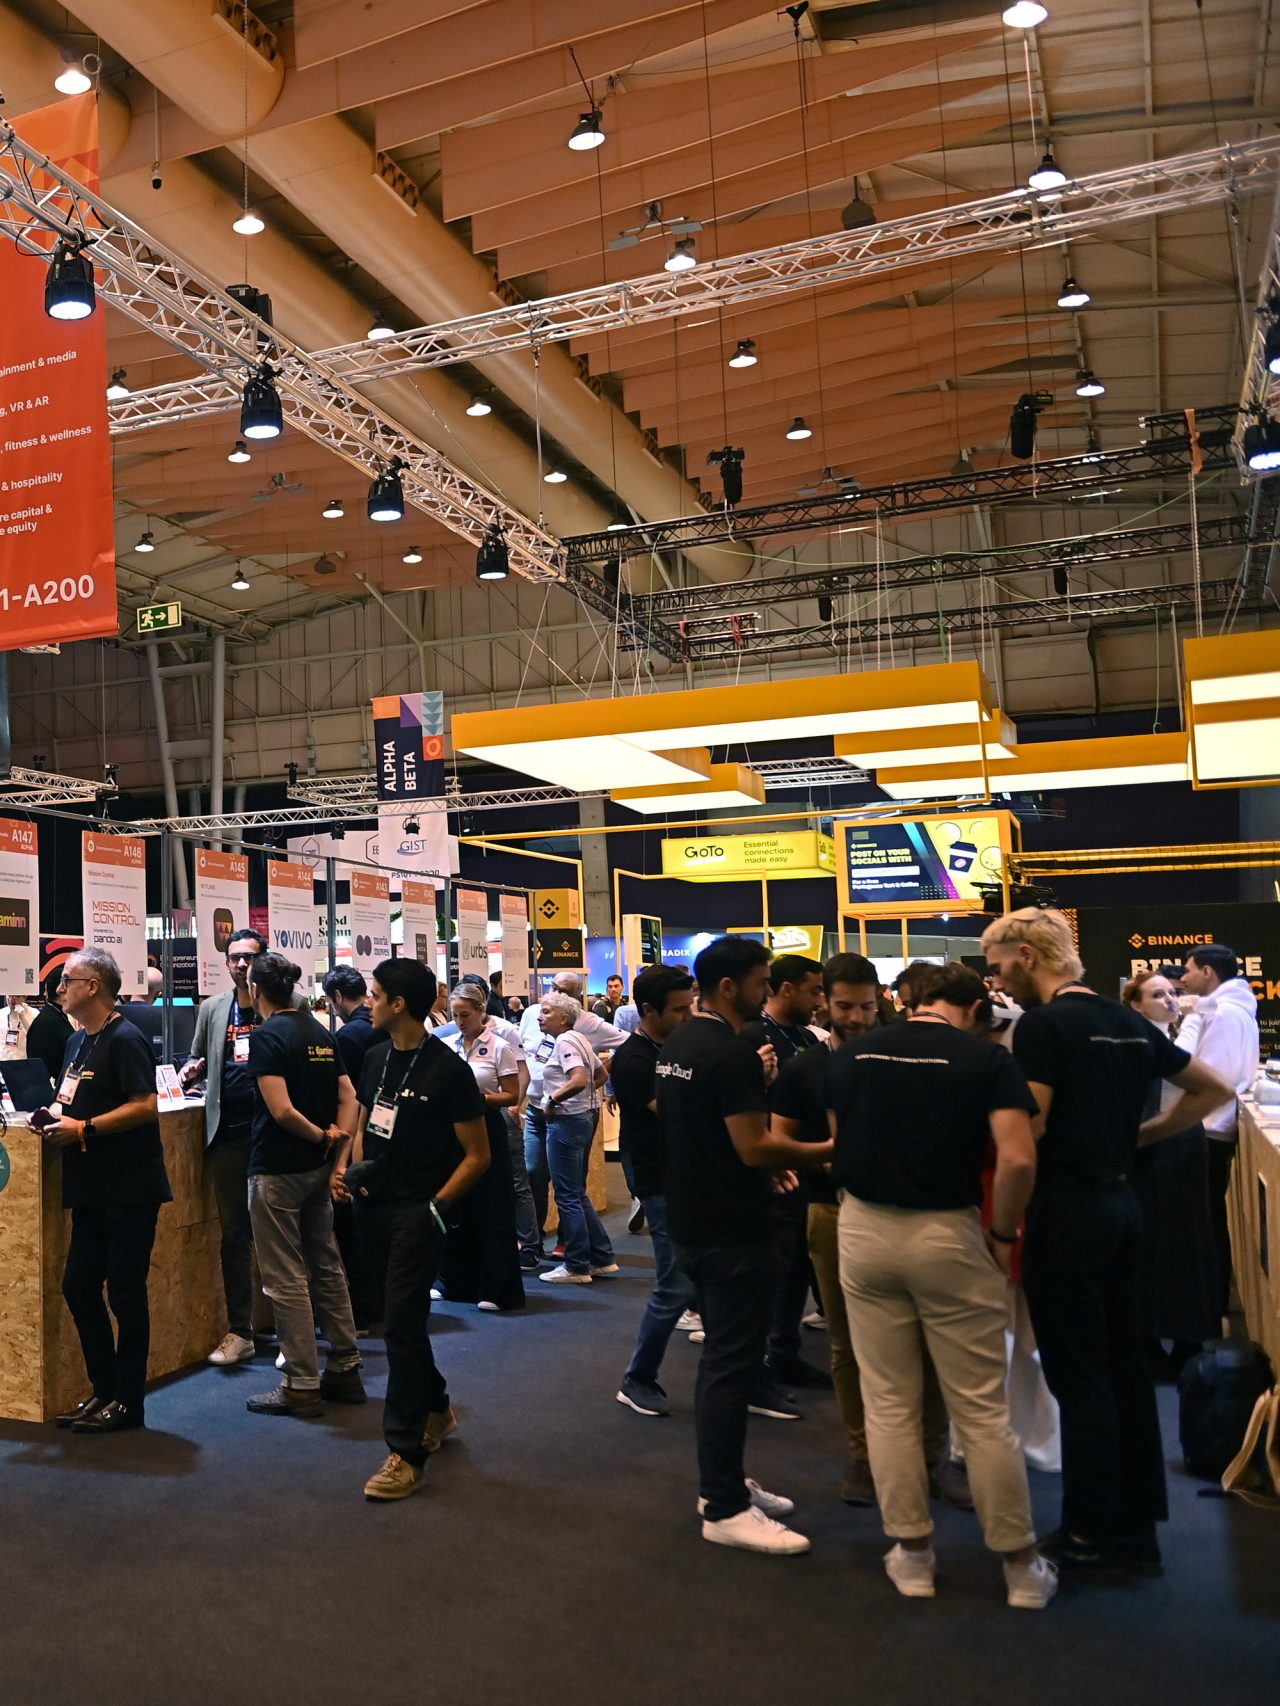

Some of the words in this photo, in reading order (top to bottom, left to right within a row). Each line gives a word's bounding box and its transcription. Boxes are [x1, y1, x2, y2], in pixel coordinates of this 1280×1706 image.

[38, 357, 45, 367] &
[47, 350, 77, 366] media
[10, 401, 24, 413] VR
[26, 400, 33, 410] &
[34, 396, 49, 407] AR
[5, 436, 38, 452] fitness
[40, 434, 47, 444] &
[49, 425, 92, 442] wellness
[1, 482, 9, 491] &
[11, 472, 63, 490] hospitality
[11, 507, 43, 523] capital
[45, 504, 53, 513] &
[7, 520, 38, 536] equity
[383, 740, 397, 792] ALPHA
[403, 751, 417, 791] BETA
[12, 829, 33, 844] A147
[400, 840, 427, 851] GIST
[743, 840, 779, 849] Essential
[124, 845, 142, 858] A146
[685, 845, 724, 858] GoTo
[744, 848, 794, 856] connections
[887, 848, 910, 856] YOUR
[769, 856, 788, 864] easy
[230, 861, 246, 873] A145
[92, 900, 131, 913] MISSION
[93, 913, 141, 926] CONTROL
[273, 929, 313, 949] YOVIVO
[1147, 934, 1214, 945] BINANCE
[661, 949, 691, 957] RADIX
